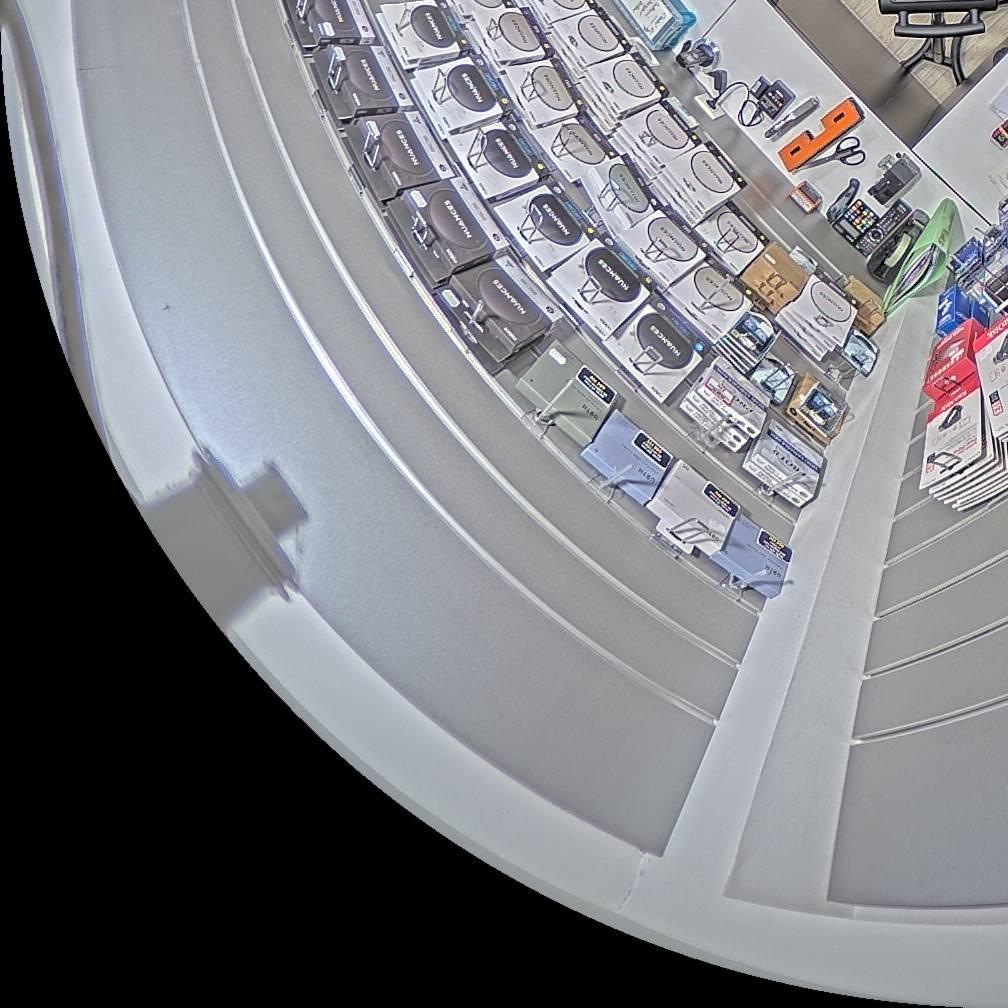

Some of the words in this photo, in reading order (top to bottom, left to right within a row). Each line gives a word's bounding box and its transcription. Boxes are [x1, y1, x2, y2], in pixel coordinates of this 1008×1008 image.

[424, 12, 443, 41] NUANCES
[359, 58, 381, 92] NUANCES
[461, 72, 483, 104] NUANCES
[395, 129, 421, 167] NUANCES
[495, 137, 520, 170] NUANCES
[443, 198, 473, 240] NUANCES
[541, 202, 571, 236] NUANCES
[598, 258, 630, 292] NUANCES
[492, 278, 528, 316] NUANCES
[649, 324, 682, 358] NUANCES
